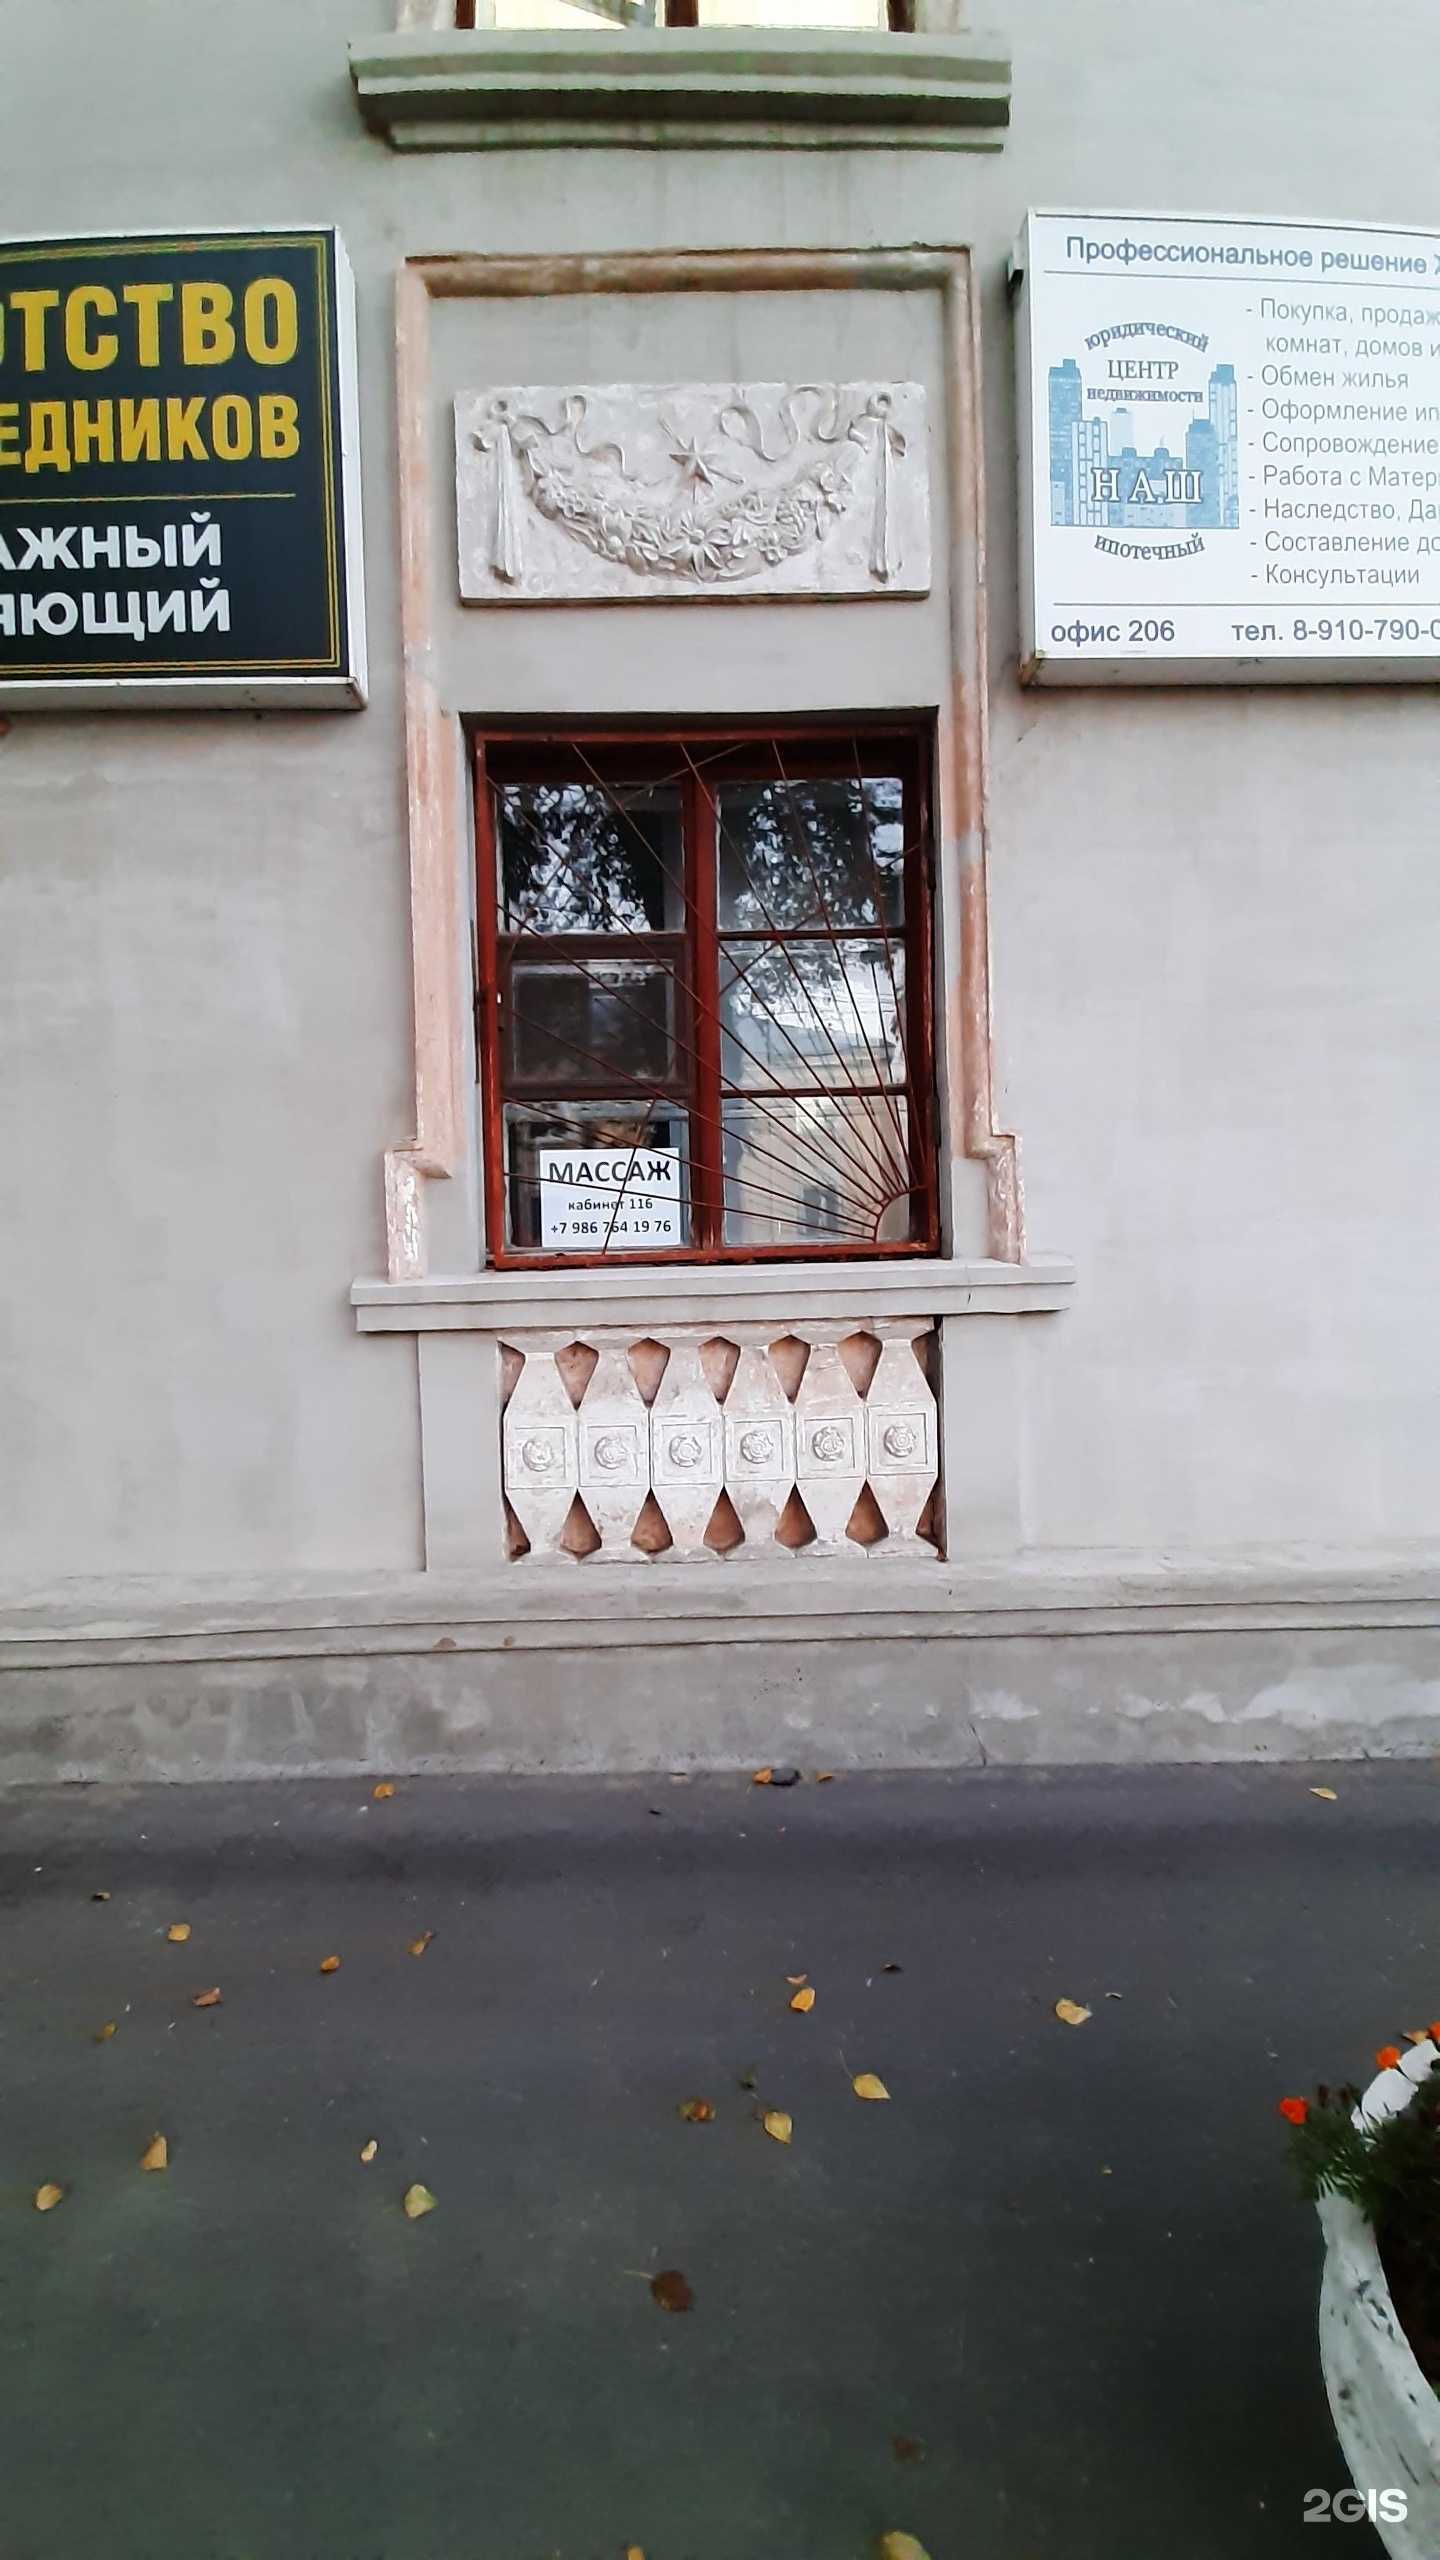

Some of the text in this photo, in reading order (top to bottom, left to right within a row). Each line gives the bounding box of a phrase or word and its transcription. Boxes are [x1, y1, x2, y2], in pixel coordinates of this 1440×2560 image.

[1066, 236, 1313, 266] Профессиональное
[1320, 250, 1427, 275] решение
[0, 278, 299, 371] ТСТВО
[1260, 298, 1353, 326] Покупка,
[1084, 322, 1209, 353] юридический
[1266, 336, 1347, 359] комнат,
[1354, 338, 1423, 358] домов
[1107, 359, 1179, 381] ЦЕНТР
[1261, 364, 1409, 389] Обмен жилья
[1086, 387, 1204, 403] недвижимости
[1261, 397, 1408, 422] Оформление
[1262, 430, 1439, 457] Сопровождение
[1263, 464, 1440, 492] Работа с Матер
[1264, 498, 1440, 523] Наследство, Да
[1094, 532, 1206, 560] ипотечный
[1264, 530, 1410, 553] Составление
[1266, 563, 1420, 589] Консультации
[1051, 619, 1121, 648] офис
[1128, 619, 1176, 643] 206
[1231, 624, 1284, 641] тел.
[549, 1160, 672, 1183] МАССАЖ
[568, 1197, 653, 1211] кабинет 116
[551, 1219, 672, 1235] +7 986 764 19 76
